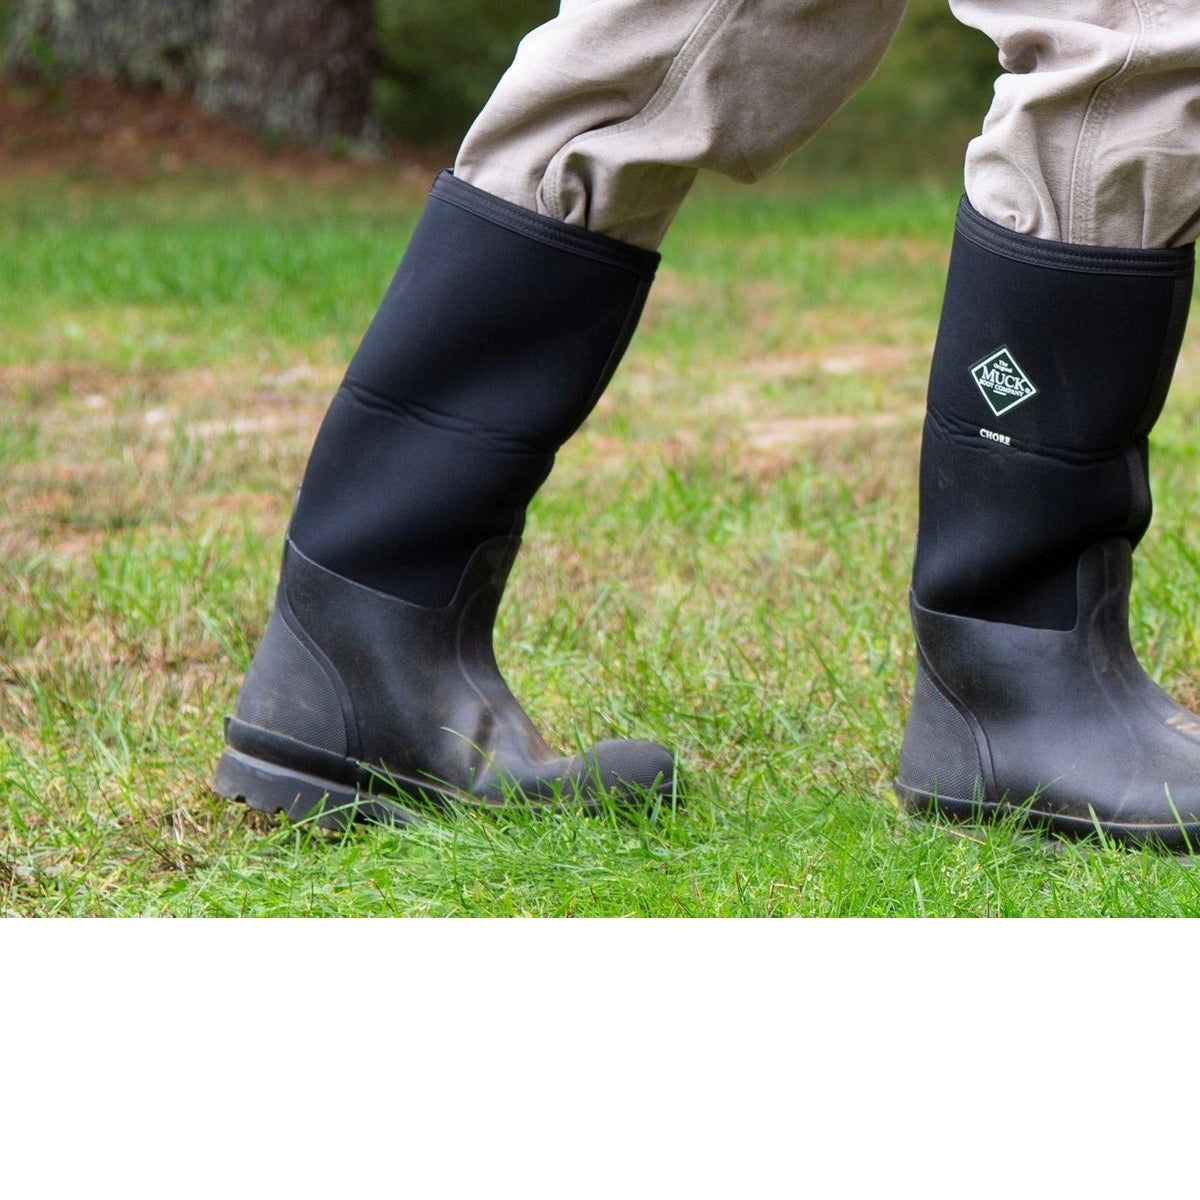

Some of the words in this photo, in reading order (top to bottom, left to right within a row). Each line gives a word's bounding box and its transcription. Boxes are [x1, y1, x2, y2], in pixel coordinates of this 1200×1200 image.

[982, 365, 1025, 391] MUCK
[995, 384, 1024, 397] COMPANY
[980, 428, 1010, 446] CHORE
